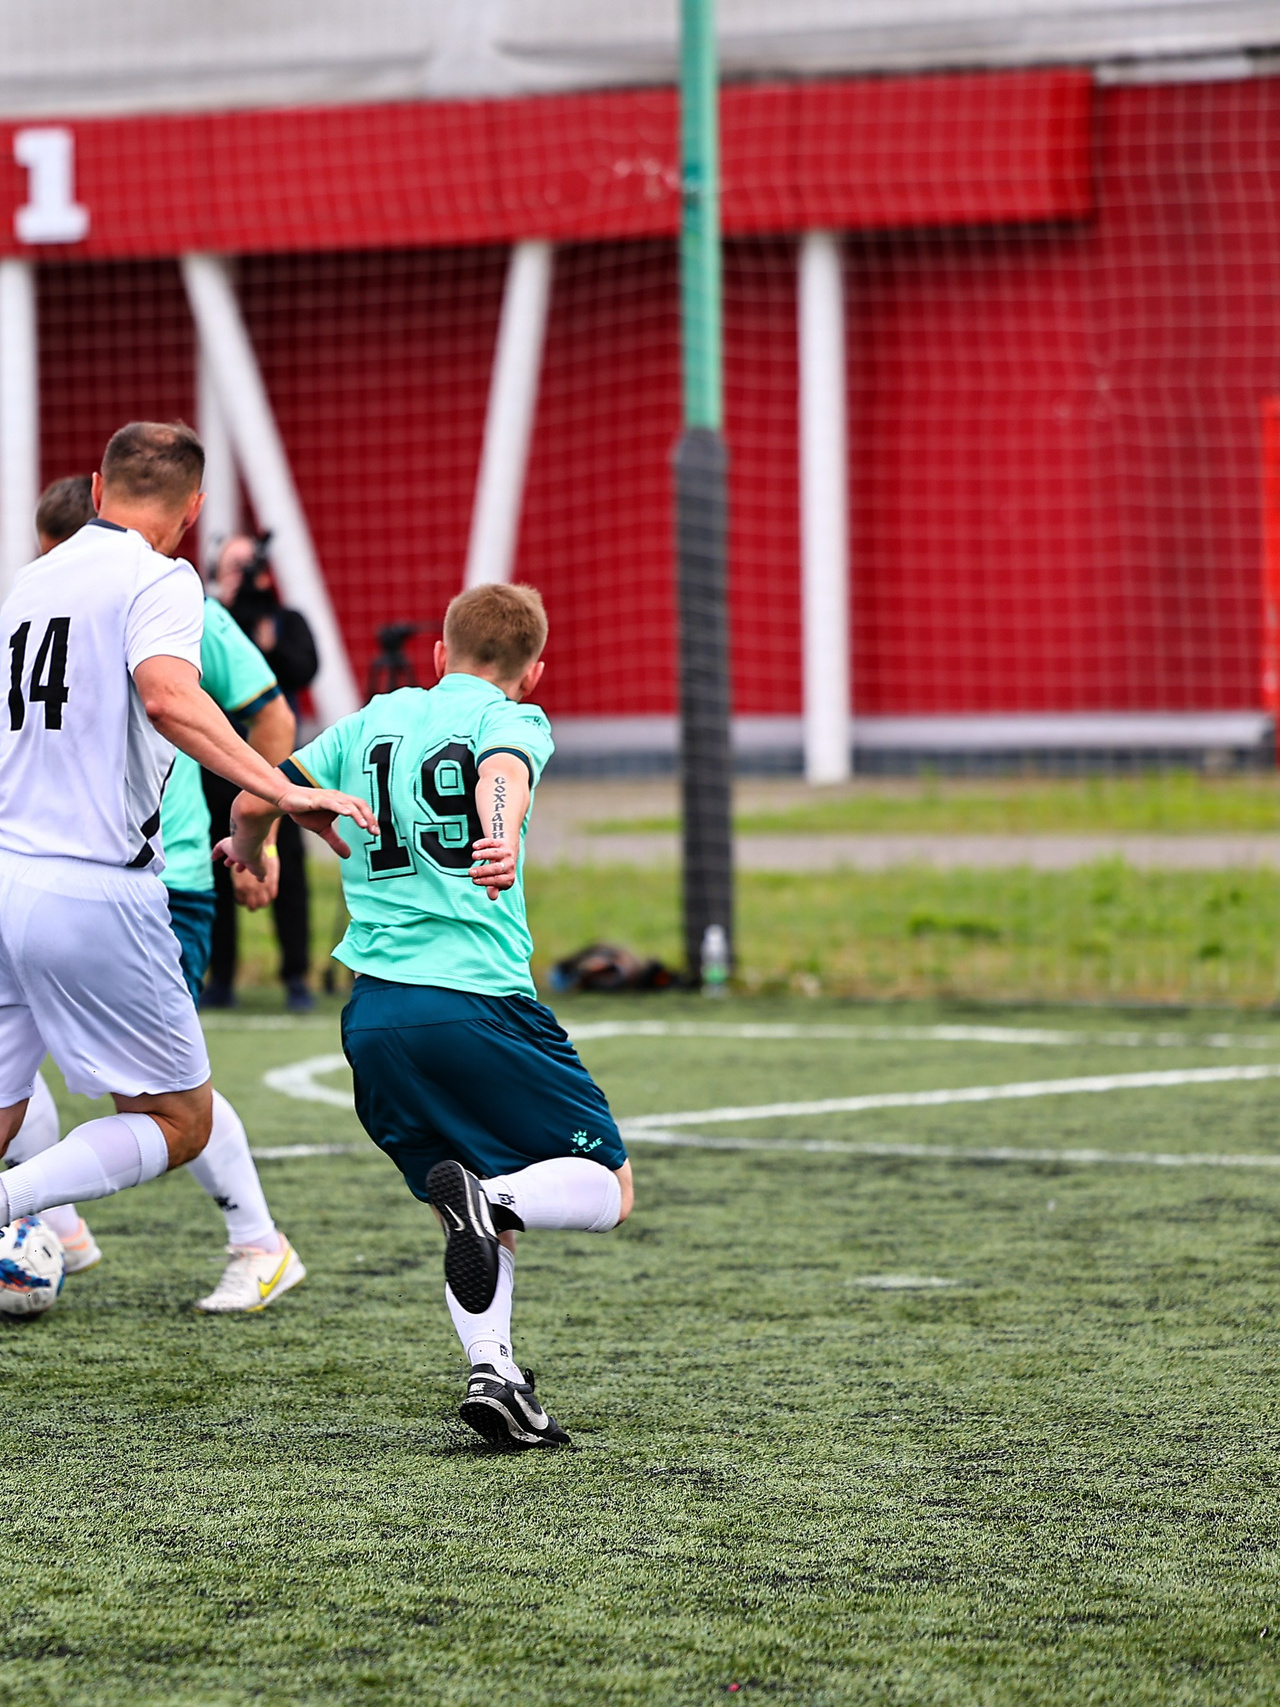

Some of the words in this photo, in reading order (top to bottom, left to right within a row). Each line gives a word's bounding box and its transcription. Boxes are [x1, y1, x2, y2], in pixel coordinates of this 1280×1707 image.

[14, 126, 90, 244] 1
[7, 617, 71, 731] 14
[363, 734, 484, 881] 19
[492, 776, 506, 839] СОХРАНИ
[571, 1137, 603, 1154] KLME
